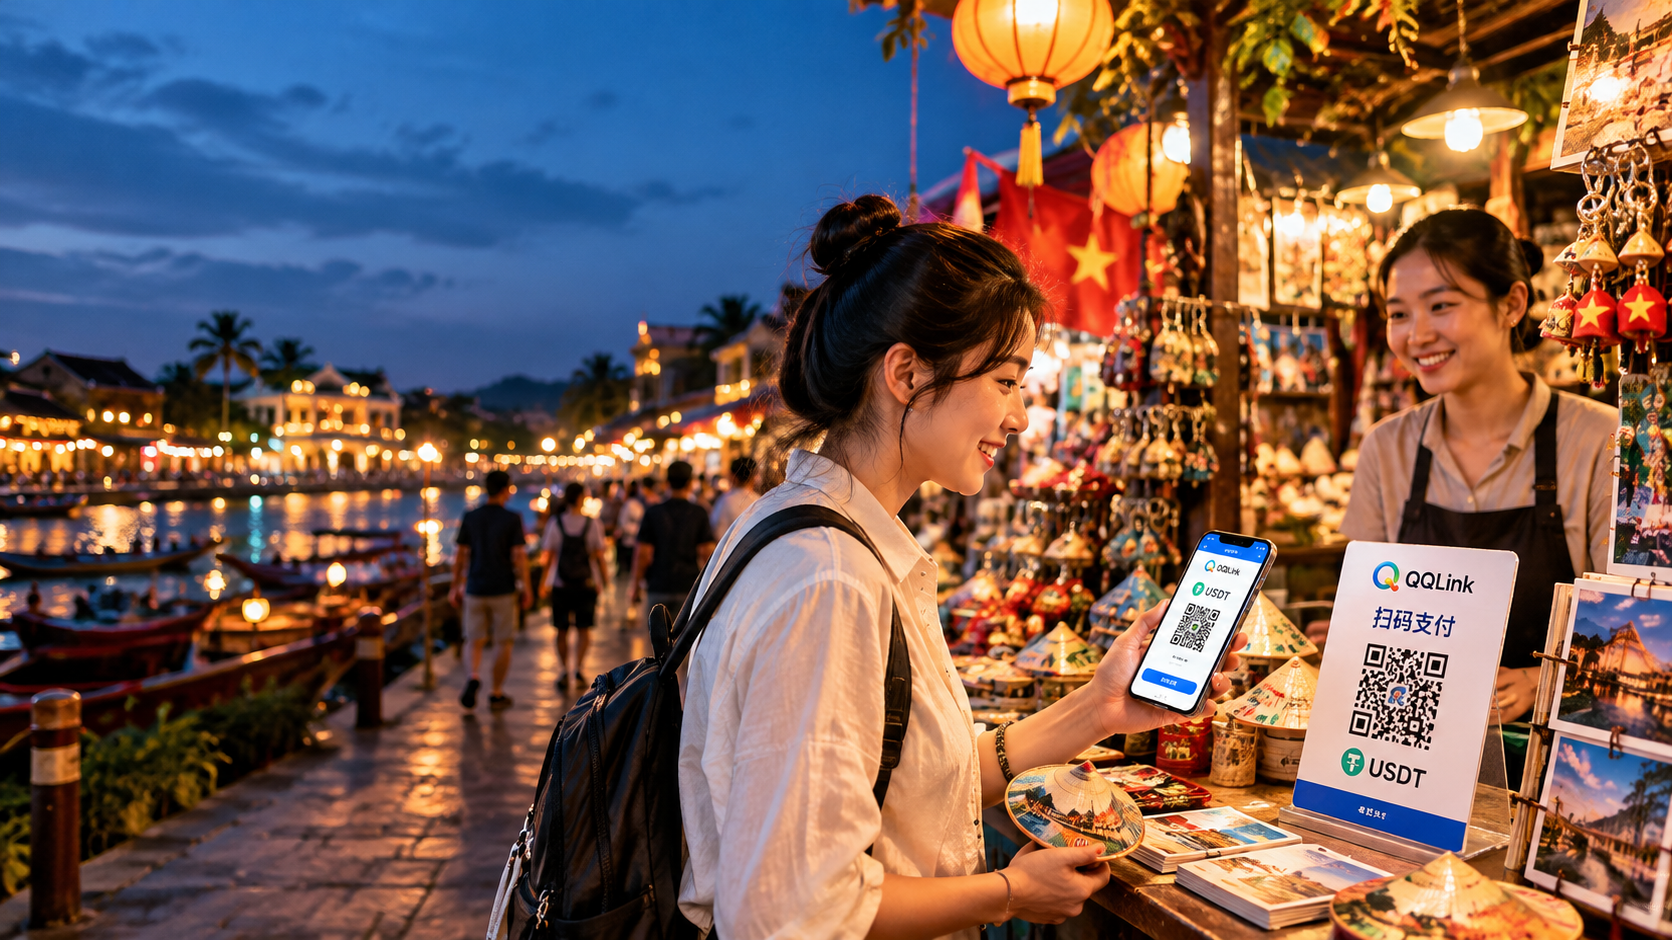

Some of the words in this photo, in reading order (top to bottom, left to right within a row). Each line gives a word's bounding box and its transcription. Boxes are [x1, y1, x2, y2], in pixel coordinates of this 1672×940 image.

[1205, 587, 1231, 601] USDT
[1405, 570, 1475, 594] QQLink
[1372, 606, 1456, 638] 扫码支付
[1369, 758, 1427, 788] USDT
